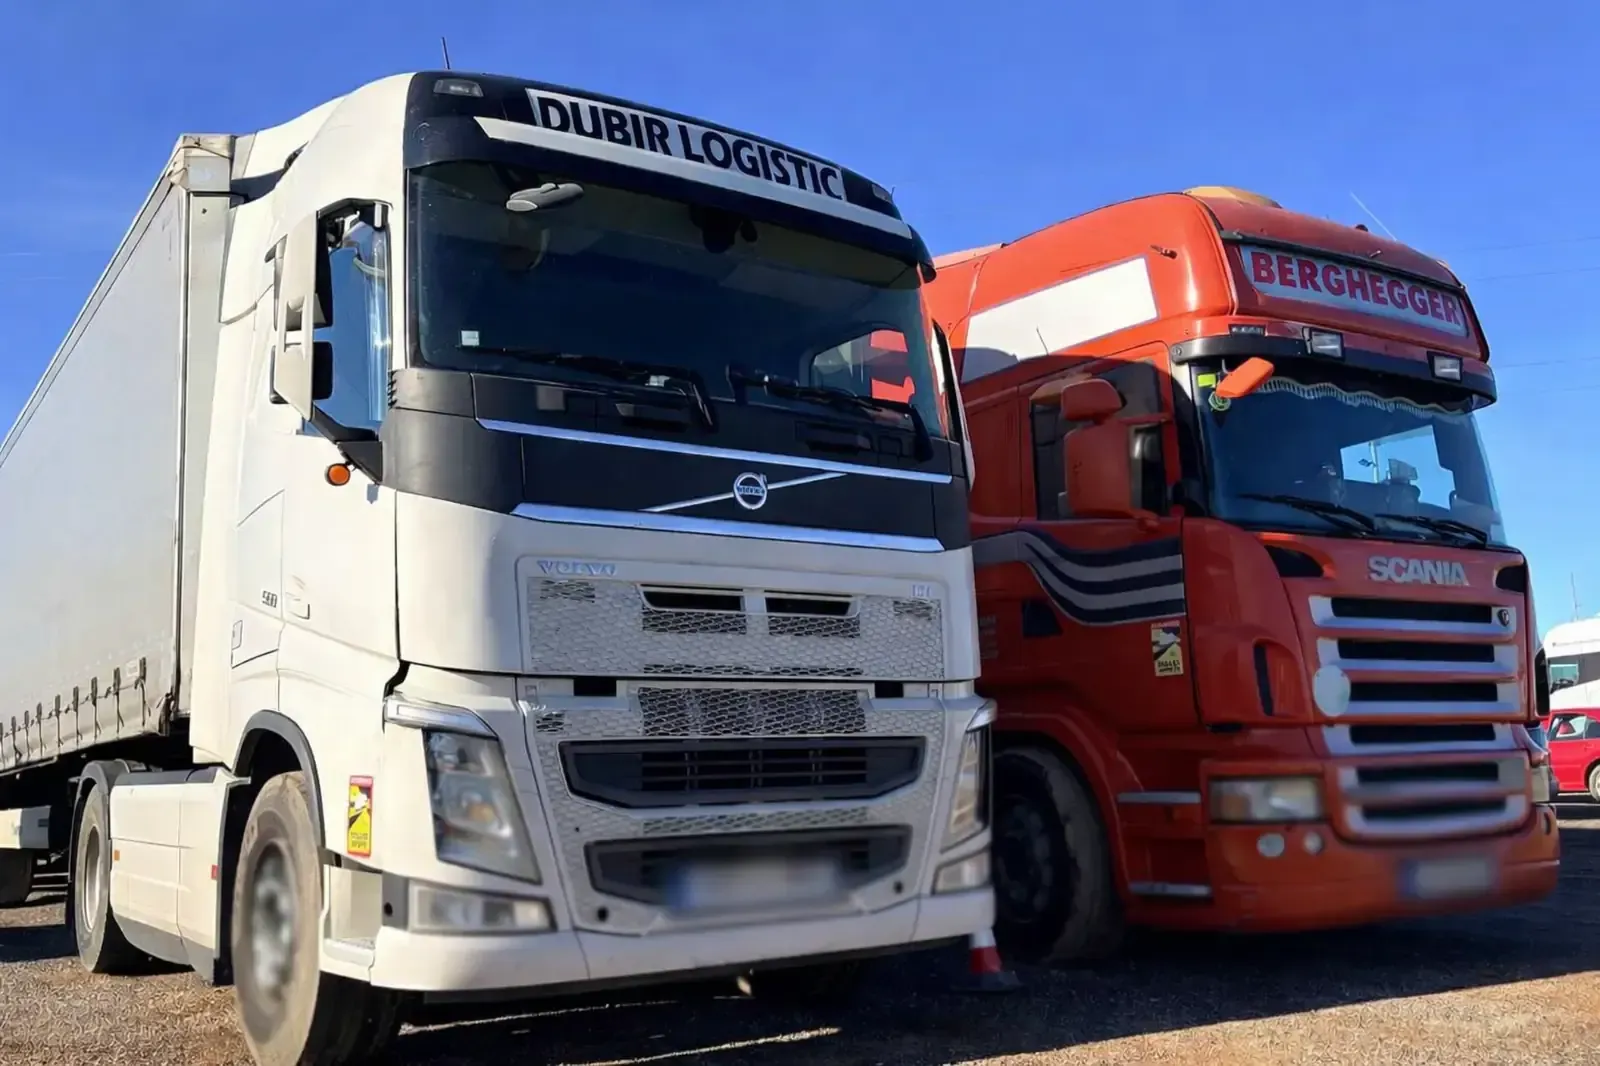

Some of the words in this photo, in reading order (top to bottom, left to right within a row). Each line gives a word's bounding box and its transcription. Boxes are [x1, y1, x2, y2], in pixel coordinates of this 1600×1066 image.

[536, 96, 672, 156] DUBIR
[678, 123, 844, 201] LOGISTIC
[1250, 251, 1461, 326] BERGHEGGER
[1367, 555, 1470, 587] SCANIA
